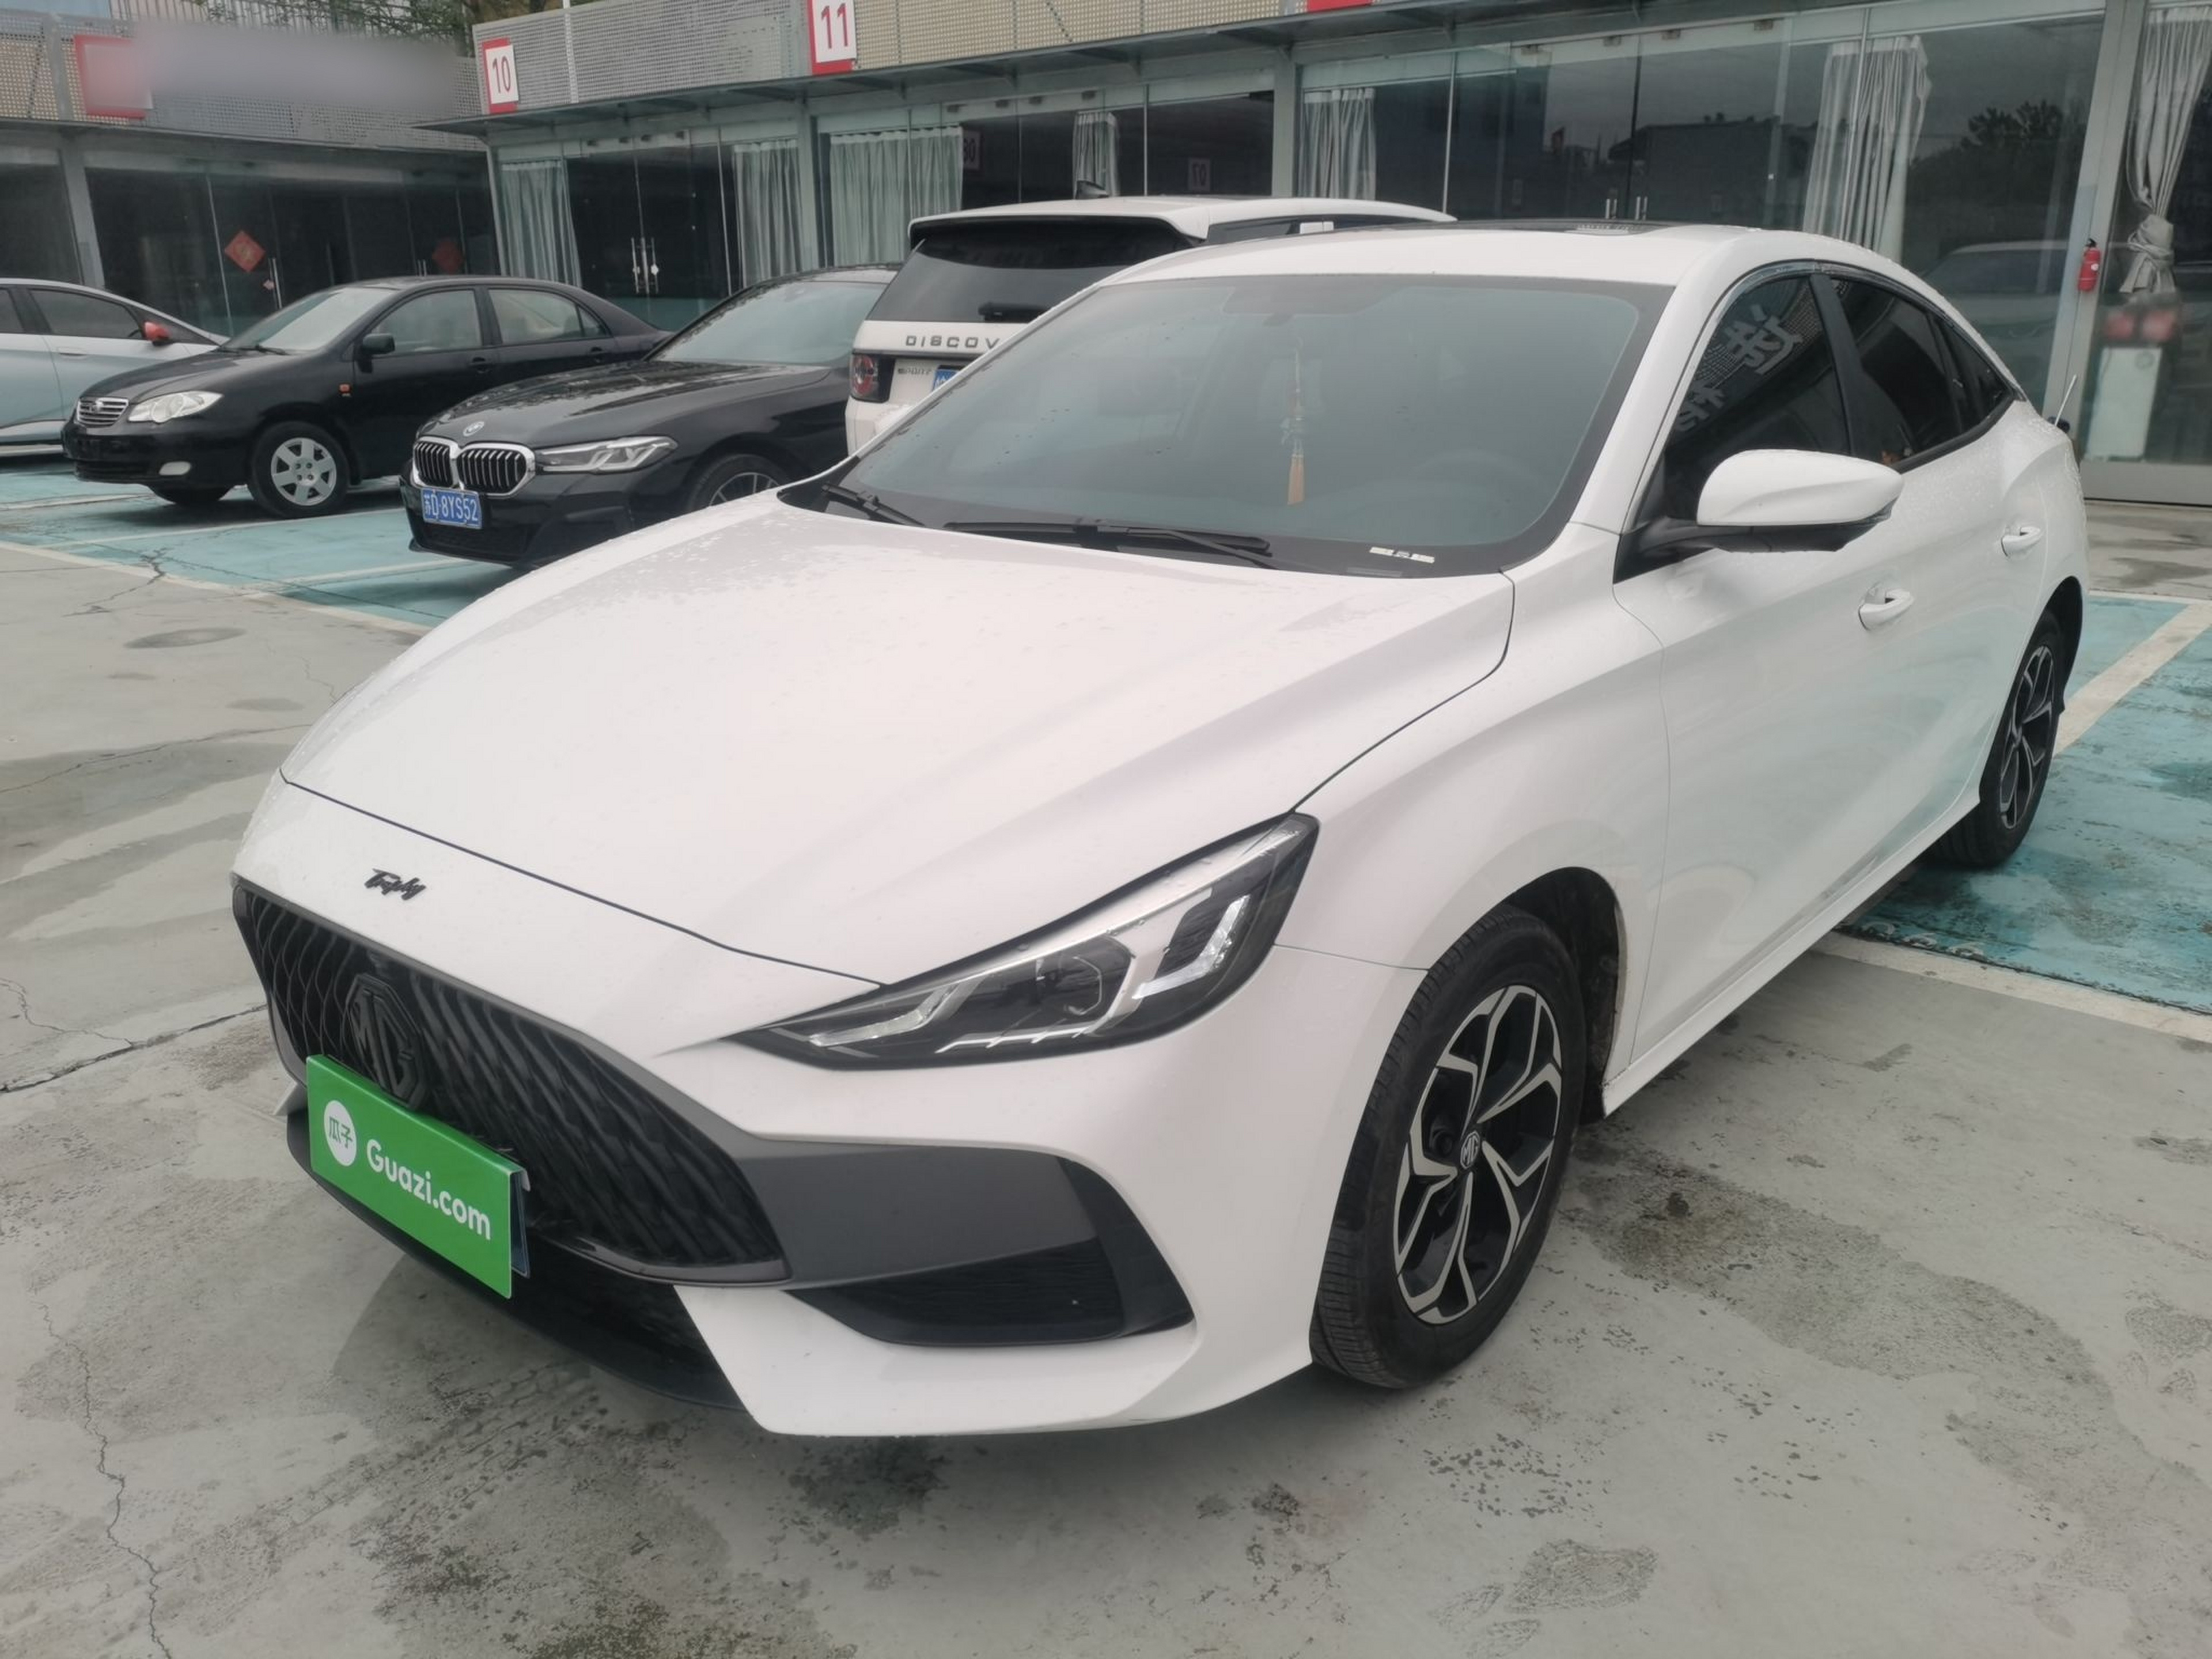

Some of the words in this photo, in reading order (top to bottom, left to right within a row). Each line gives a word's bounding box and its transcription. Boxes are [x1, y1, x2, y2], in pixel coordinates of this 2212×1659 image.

[821, 3, 848, 49] 11
[493, 56, 511, 94] 10
[350, 985, 416, 1098] MG
[329, 1116, 353, 1149] 瓜子
[1463, 1135, 1479, 1165] MG
[366, 1139, 491, 1241] Guazi.com
